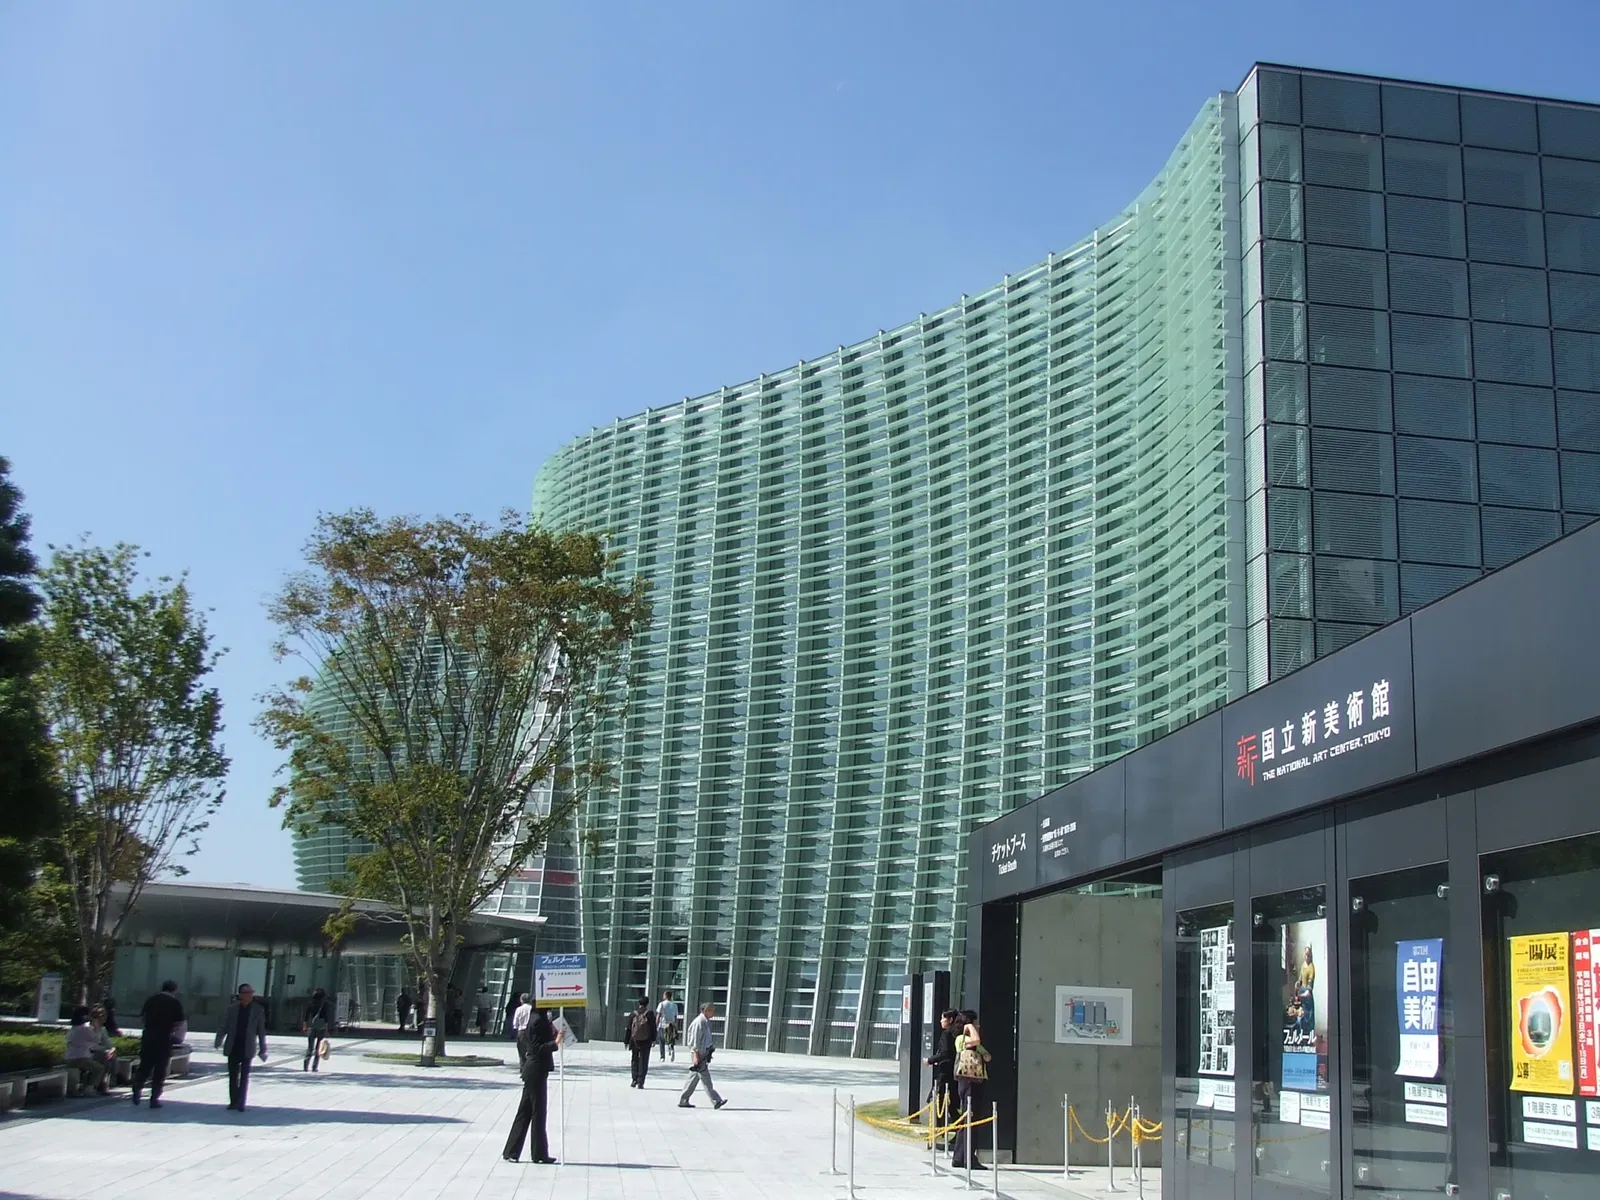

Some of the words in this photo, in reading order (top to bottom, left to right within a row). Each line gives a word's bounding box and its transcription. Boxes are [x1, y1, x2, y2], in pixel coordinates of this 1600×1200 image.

[1261, 679, 1389, 763] 国立新美術館
[1262, 768, 1276, 782] THE
[1276, 756, 1311, 777] NATIONAL
[1313, 749, 1328, 763] ART
[991, 832, 1027, 863] チケットブース
[541, 955, 581, 964] フェルメール
[1515, 943, 1557, 961] 一陽展
[1403, 958, 1438, 993] 自由
[1403, 995, 1437, 1030] 美術
[1283, 1029, 1317, 1045] フェルメール
[1527, 1101, 1558, 1115] 1階展示室
[1562, 1104, 1572, 1117] 1C
